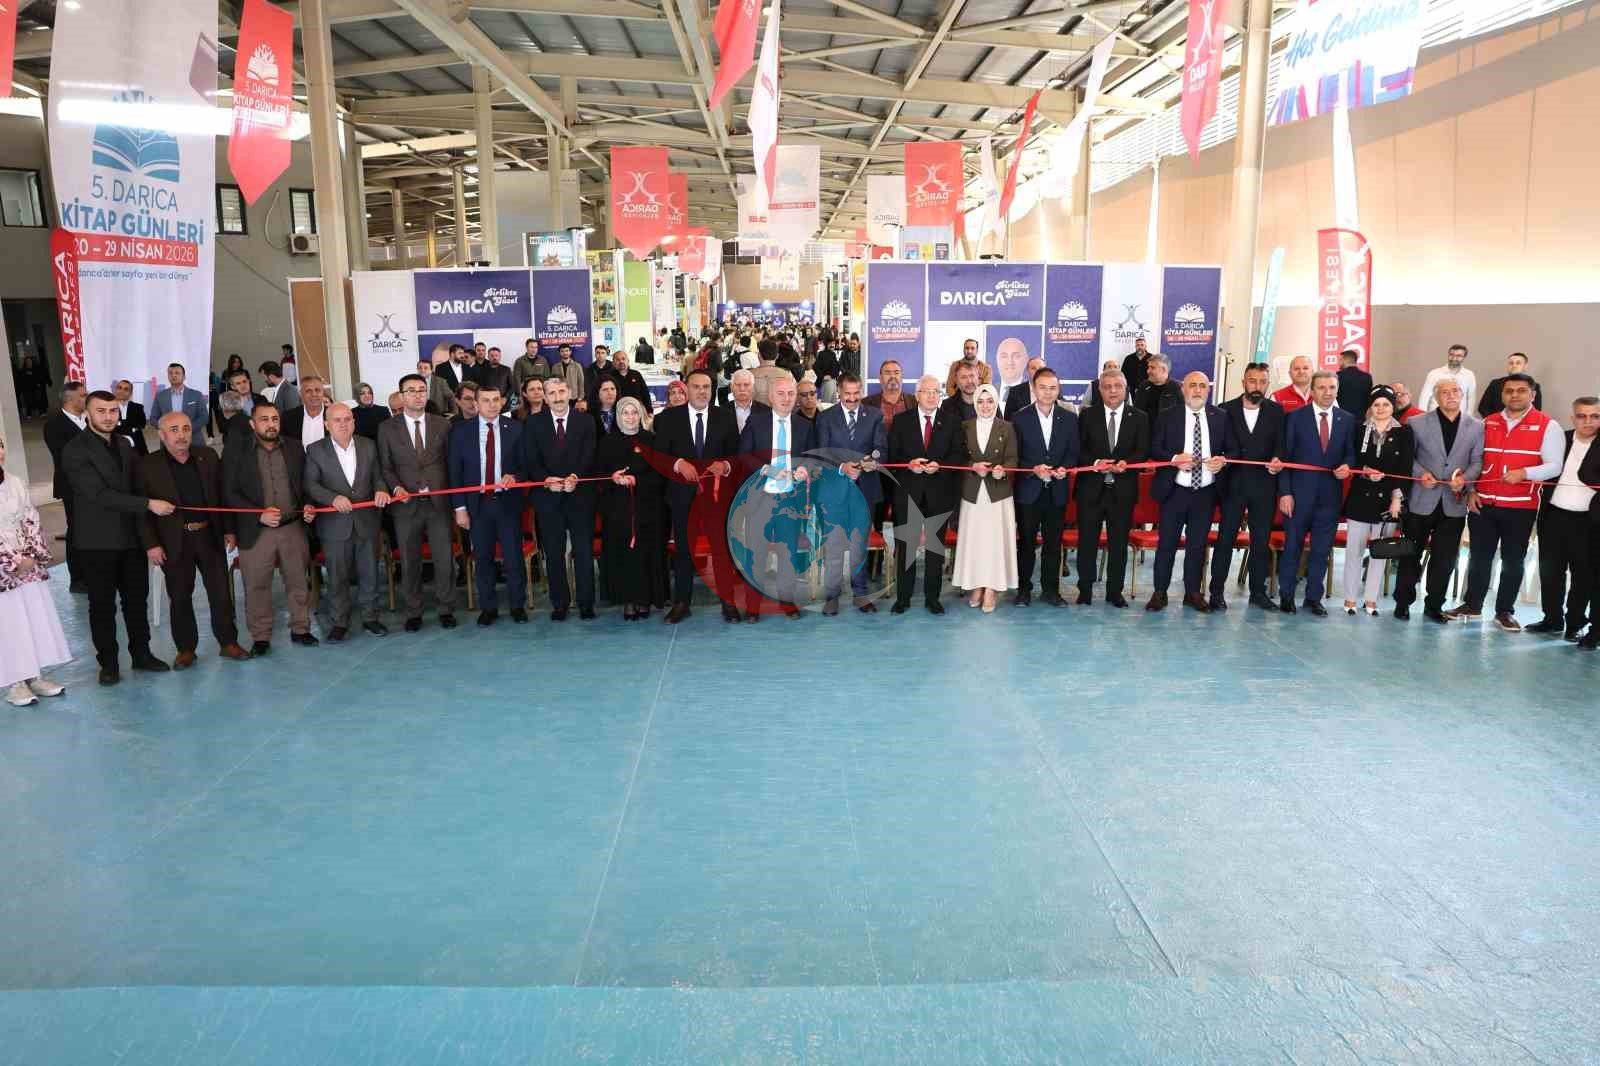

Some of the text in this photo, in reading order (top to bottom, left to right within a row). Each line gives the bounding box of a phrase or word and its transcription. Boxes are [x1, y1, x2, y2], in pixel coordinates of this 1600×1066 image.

[91, 175, 178, 212] 5. DARICA
[61, 197, 204, 246] KİTAP GÜNLERİ
[104, 239, 117, 257] 29
[120, 238, 163, 259] NİSAN
[163, 245, 194, 263] 2026
[429, 299, 495, 314] DARICA
[940, 291, 1006, 305] DARICA
[54, 250, 82, 383] DARICA
[372, 340, 402, 349] DARICA
[1114, 331, 1145, 339] DARICA
